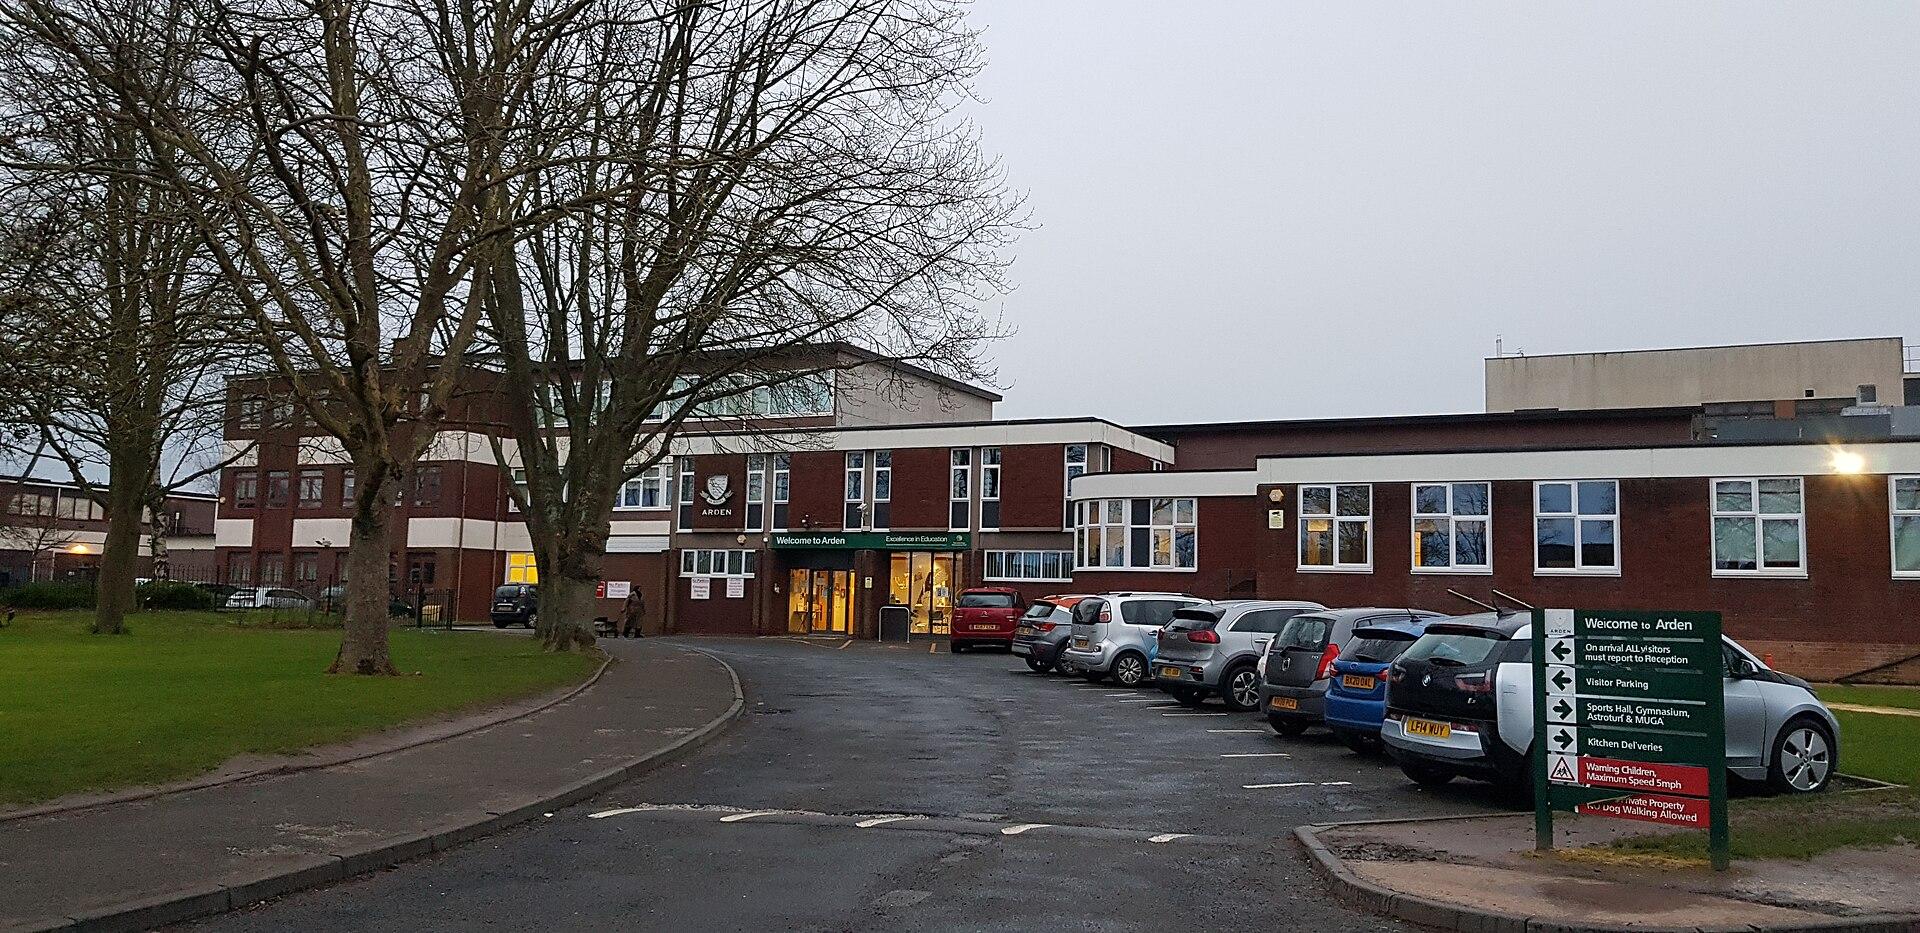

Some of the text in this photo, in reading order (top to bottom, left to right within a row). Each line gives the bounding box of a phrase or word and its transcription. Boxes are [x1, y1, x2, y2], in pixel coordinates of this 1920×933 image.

[701, 508, 732, 516] ARDEN
[776, 536, 846, 545] Welcome to Arden
[885, 535, 914, 543] Excellence
[920, 535, 948, 543] Education
[1641, 621, 1651, 630] to
[1655, 618, 1693, 630] Arden
[1585, 643, 1598, 652] On
[1598, 643, 1624, 653] arrival
[1625, 644, 1641, 653] ALL
[1585, 653, 1689, 665] must report to Reception
[1585, 677, 1649, 691] Visitor Parking
[1586, 702, 1690, 719] Sports Hall, Gymnasium,
[1586, 712, 1665, 726] Astroturf & MUGA
[1587, 737, 1620, 749] Kitchen
[1585, 762, 1657, 777] Warning Children,
[1586, 772, 1682, 790] Maximum Speed 5mph
[1648, 798, 1685, 812] Property
[1602, 804, 1621, 815] Dog
[1622, 805, 1658, 818] Walking
[1659, 811, 1698, 822] Allowed
